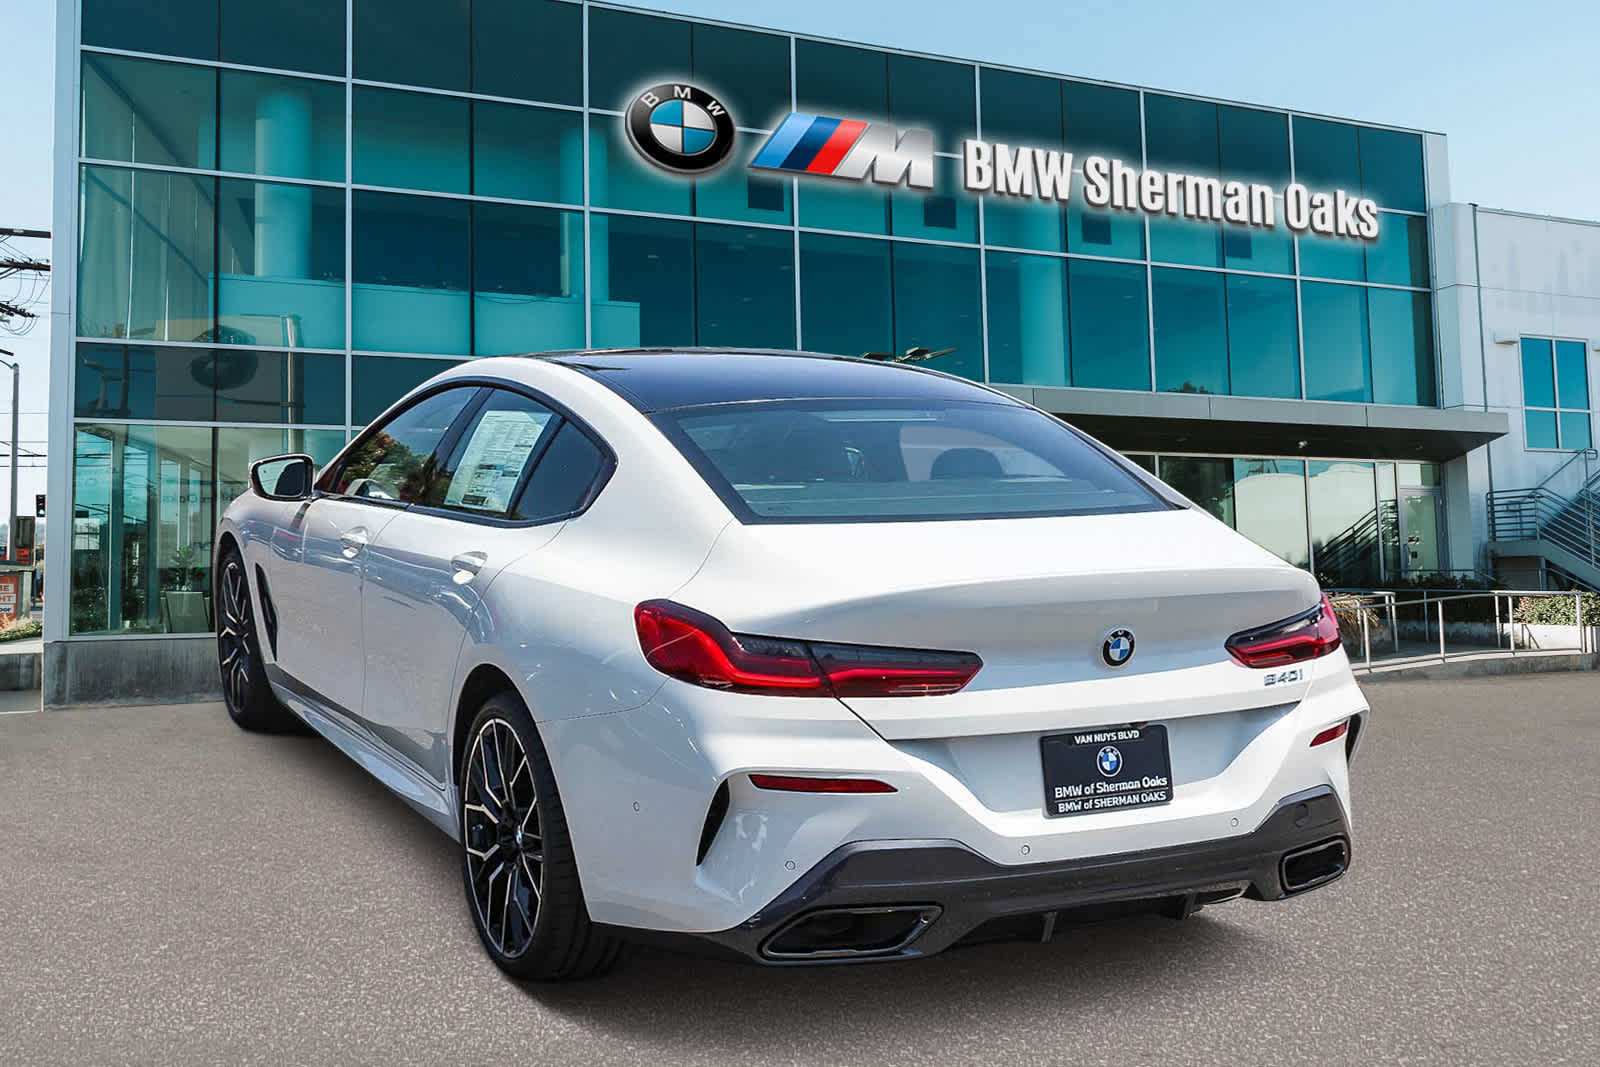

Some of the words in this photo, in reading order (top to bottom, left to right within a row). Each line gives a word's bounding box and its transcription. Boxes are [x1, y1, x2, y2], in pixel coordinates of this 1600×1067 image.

[640, 85, 725, 117] BMW
[963, 139, 1073, 201] BMW
[1083, 156, 1274, 227] Sherman
[1283, 183, 1380, 240] Oaks
[1074, 735, 1093, 744] VAN
[1094, 733, 1116, 743] NUYS
[1118, 730, 1140, 740] BLVD
[1055, 785, 1082, 798] BMW
[1084, 783, 1095, 794] of
[1096, 780, 1141, 793] Sherman
[1142, 776, 1168, 787] Oaks
[1058, 801, 1082, 813] BMW
[1084, 800, 1093, 809] of
[1094, 795, 1140, 808] SHERMAN
[1141, 791, 1166, 802] OAKS
